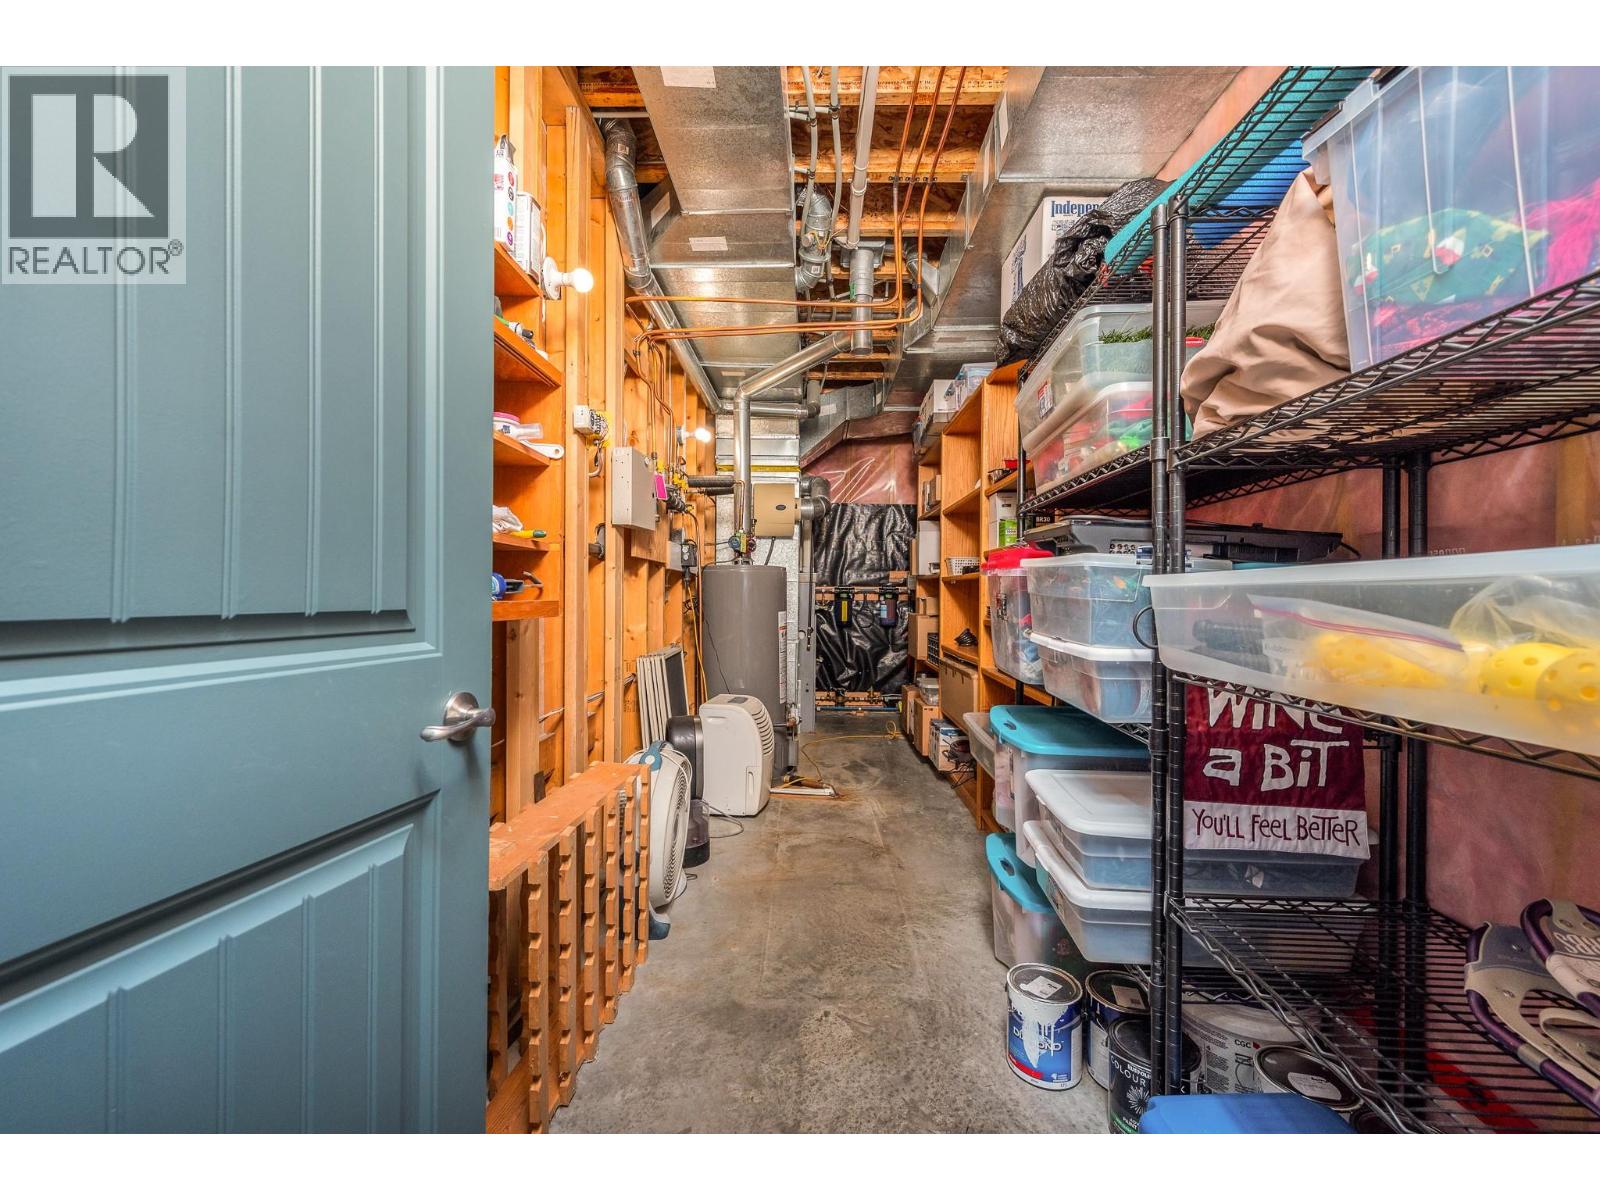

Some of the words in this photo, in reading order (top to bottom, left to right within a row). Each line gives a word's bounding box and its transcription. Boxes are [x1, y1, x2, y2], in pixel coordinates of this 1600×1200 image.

[1203, 748, 1242, 787] a
[1234, 1039, 1251, 1049] CGC
[1110, 1055, 1147, 1088] COLOUR
